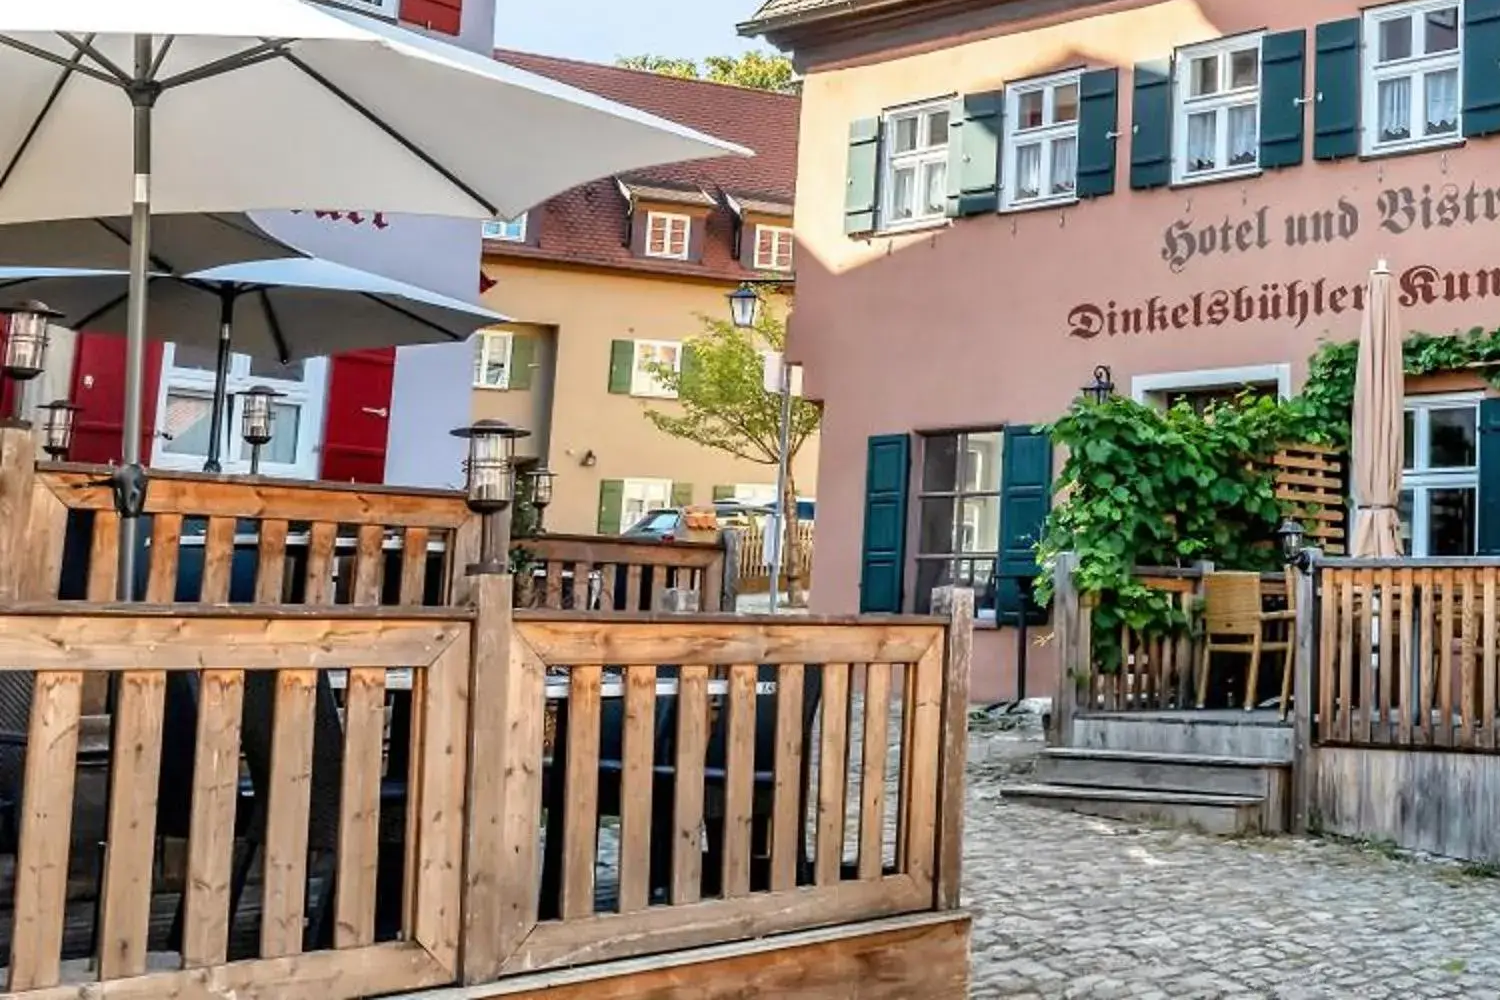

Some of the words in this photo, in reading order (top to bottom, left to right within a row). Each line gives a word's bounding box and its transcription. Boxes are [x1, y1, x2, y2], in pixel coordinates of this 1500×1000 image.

[1161, 206, 1269, 272] Hotel
[1284, 199, 1359, 246] und
[1067, 277, 1368, 340] Dinkelsbühler
